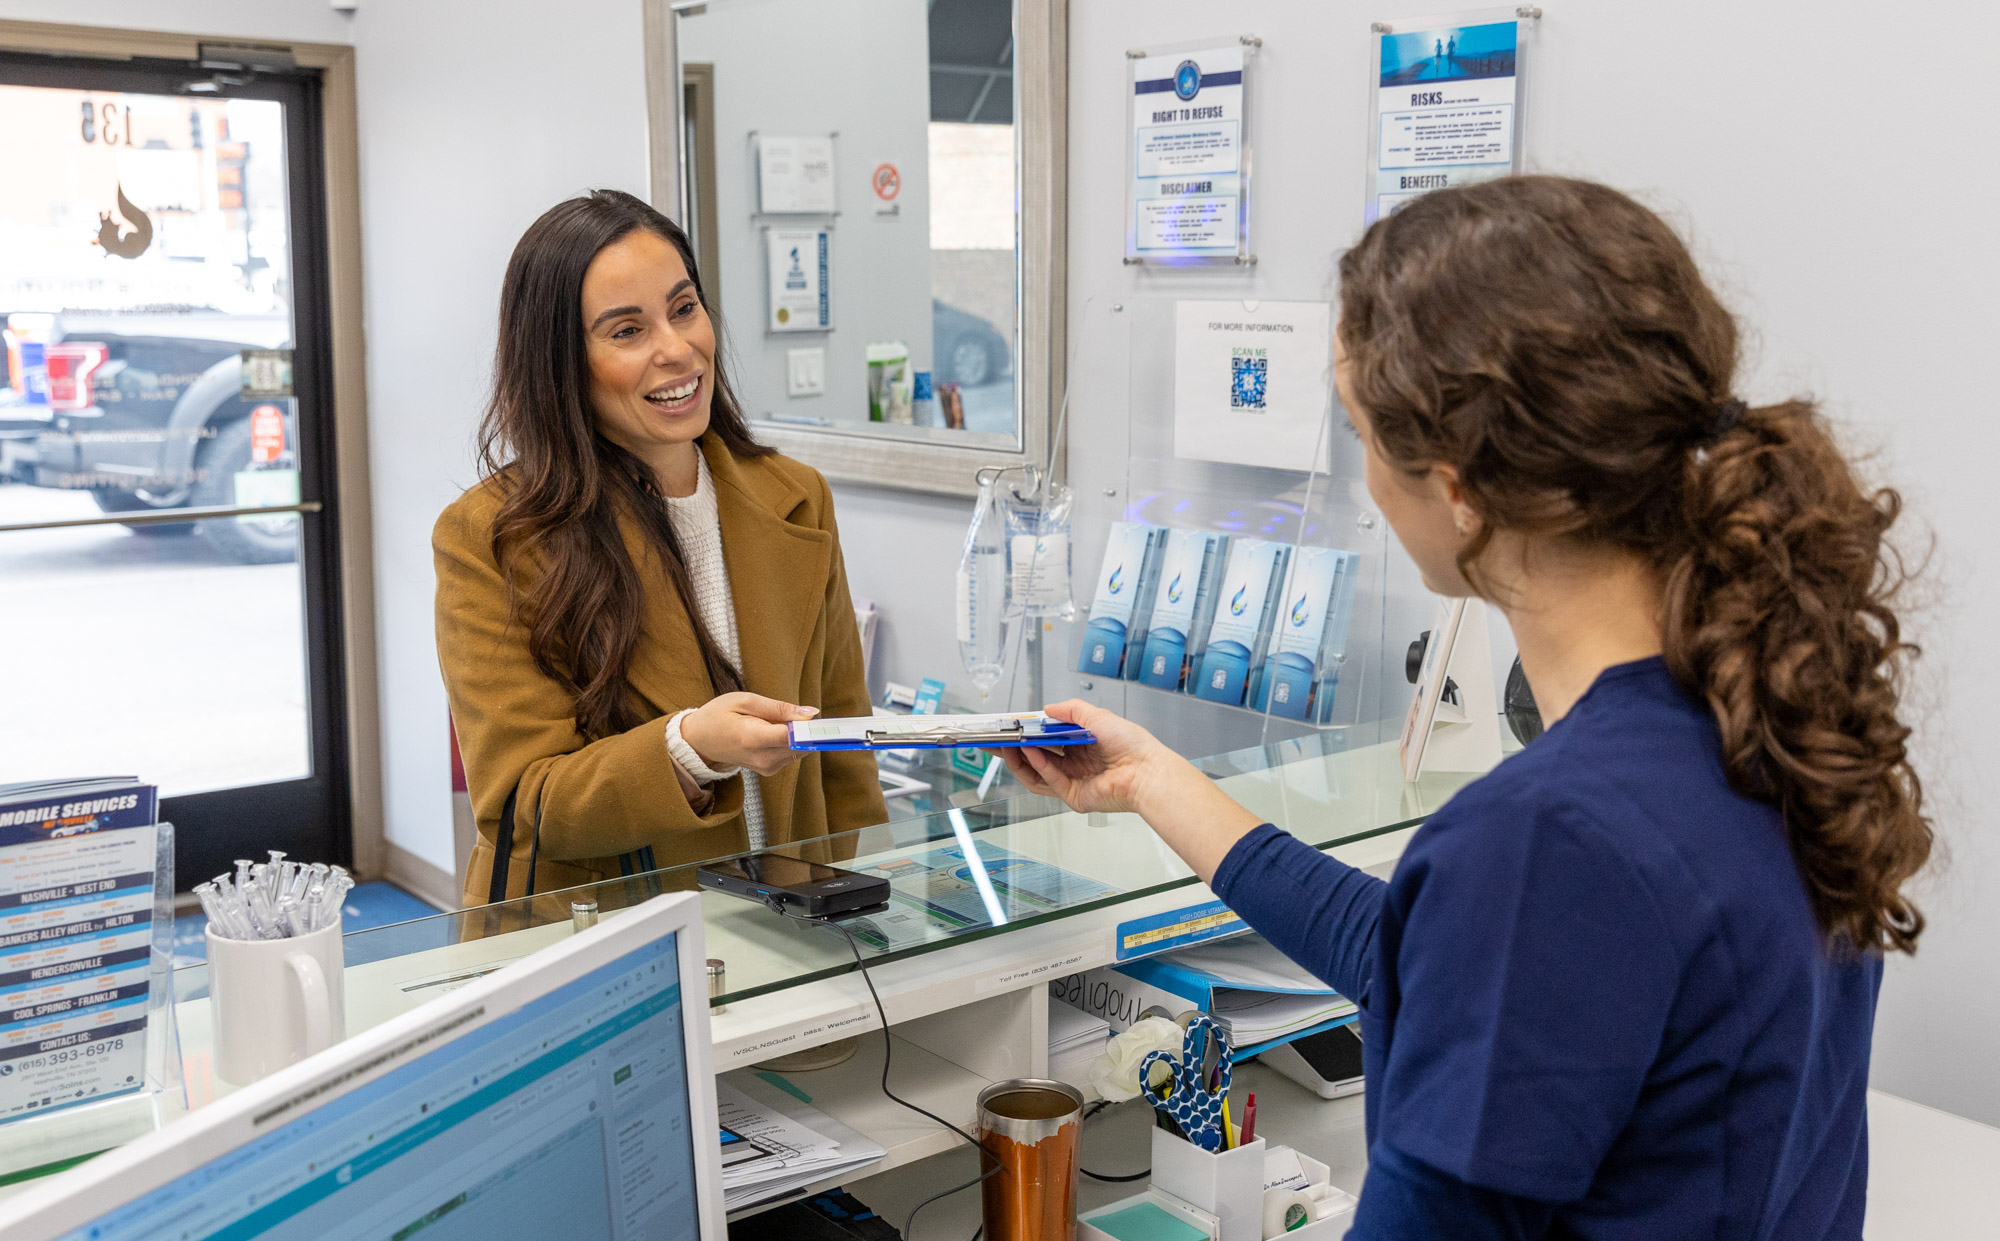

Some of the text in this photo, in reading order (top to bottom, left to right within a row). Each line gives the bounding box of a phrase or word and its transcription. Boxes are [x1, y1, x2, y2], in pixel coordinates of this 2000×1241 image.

[1411, 92, 1442, 106] RISKS
[1152, 106, 1224, 124] RIGHT TO REFUSE
[1161, 182, 1212, 196] DISCLAIMER
[1400, 174, 1448, 189] BENEFITS
[1208, 322, 1294, 333] FOR MORE INFORMATION
[1232, 348, 1267, 357] SCAN ME
[0, 794, 138, 828] MOBILE SERVICES
[21, 887, 68, 904] NASHVILLE
[74, 882, 98, 896] WEST
[99, 879, 116, 891] END
[1194, 909, 1207, 918] DOSE
[0, 932, 39, 946] BANKERS
[40, 927, 67, 940] ALLEY
[67, 922, 93, 935] HOTEL
[105, 914, 134, 928] HILTON
[31, 957, 103, 980] HENDERSONVILLE
[1013, 971, 1030, 980] Free
[1031, 965, 1048, 975] (833)
[1050, 956, 1082, 969] 487-6567
[14, 1008, 34, 1021] COOL
[36, 1000, 72, 1016] SPRINGS
[78, 990, 118, 1007] FRANKLIN
[1055, 974, 1142, 1026] mobiles
[40, 1032, 91, 1051] CONTACT US:
[733, 1013, 871, 1056] IVSOLNSGuest pass: Welcomeall
[18, 1038, 124, 1072] (615) 393-6978
[30, 1077, 101, 1098] www.IVSolns.com
